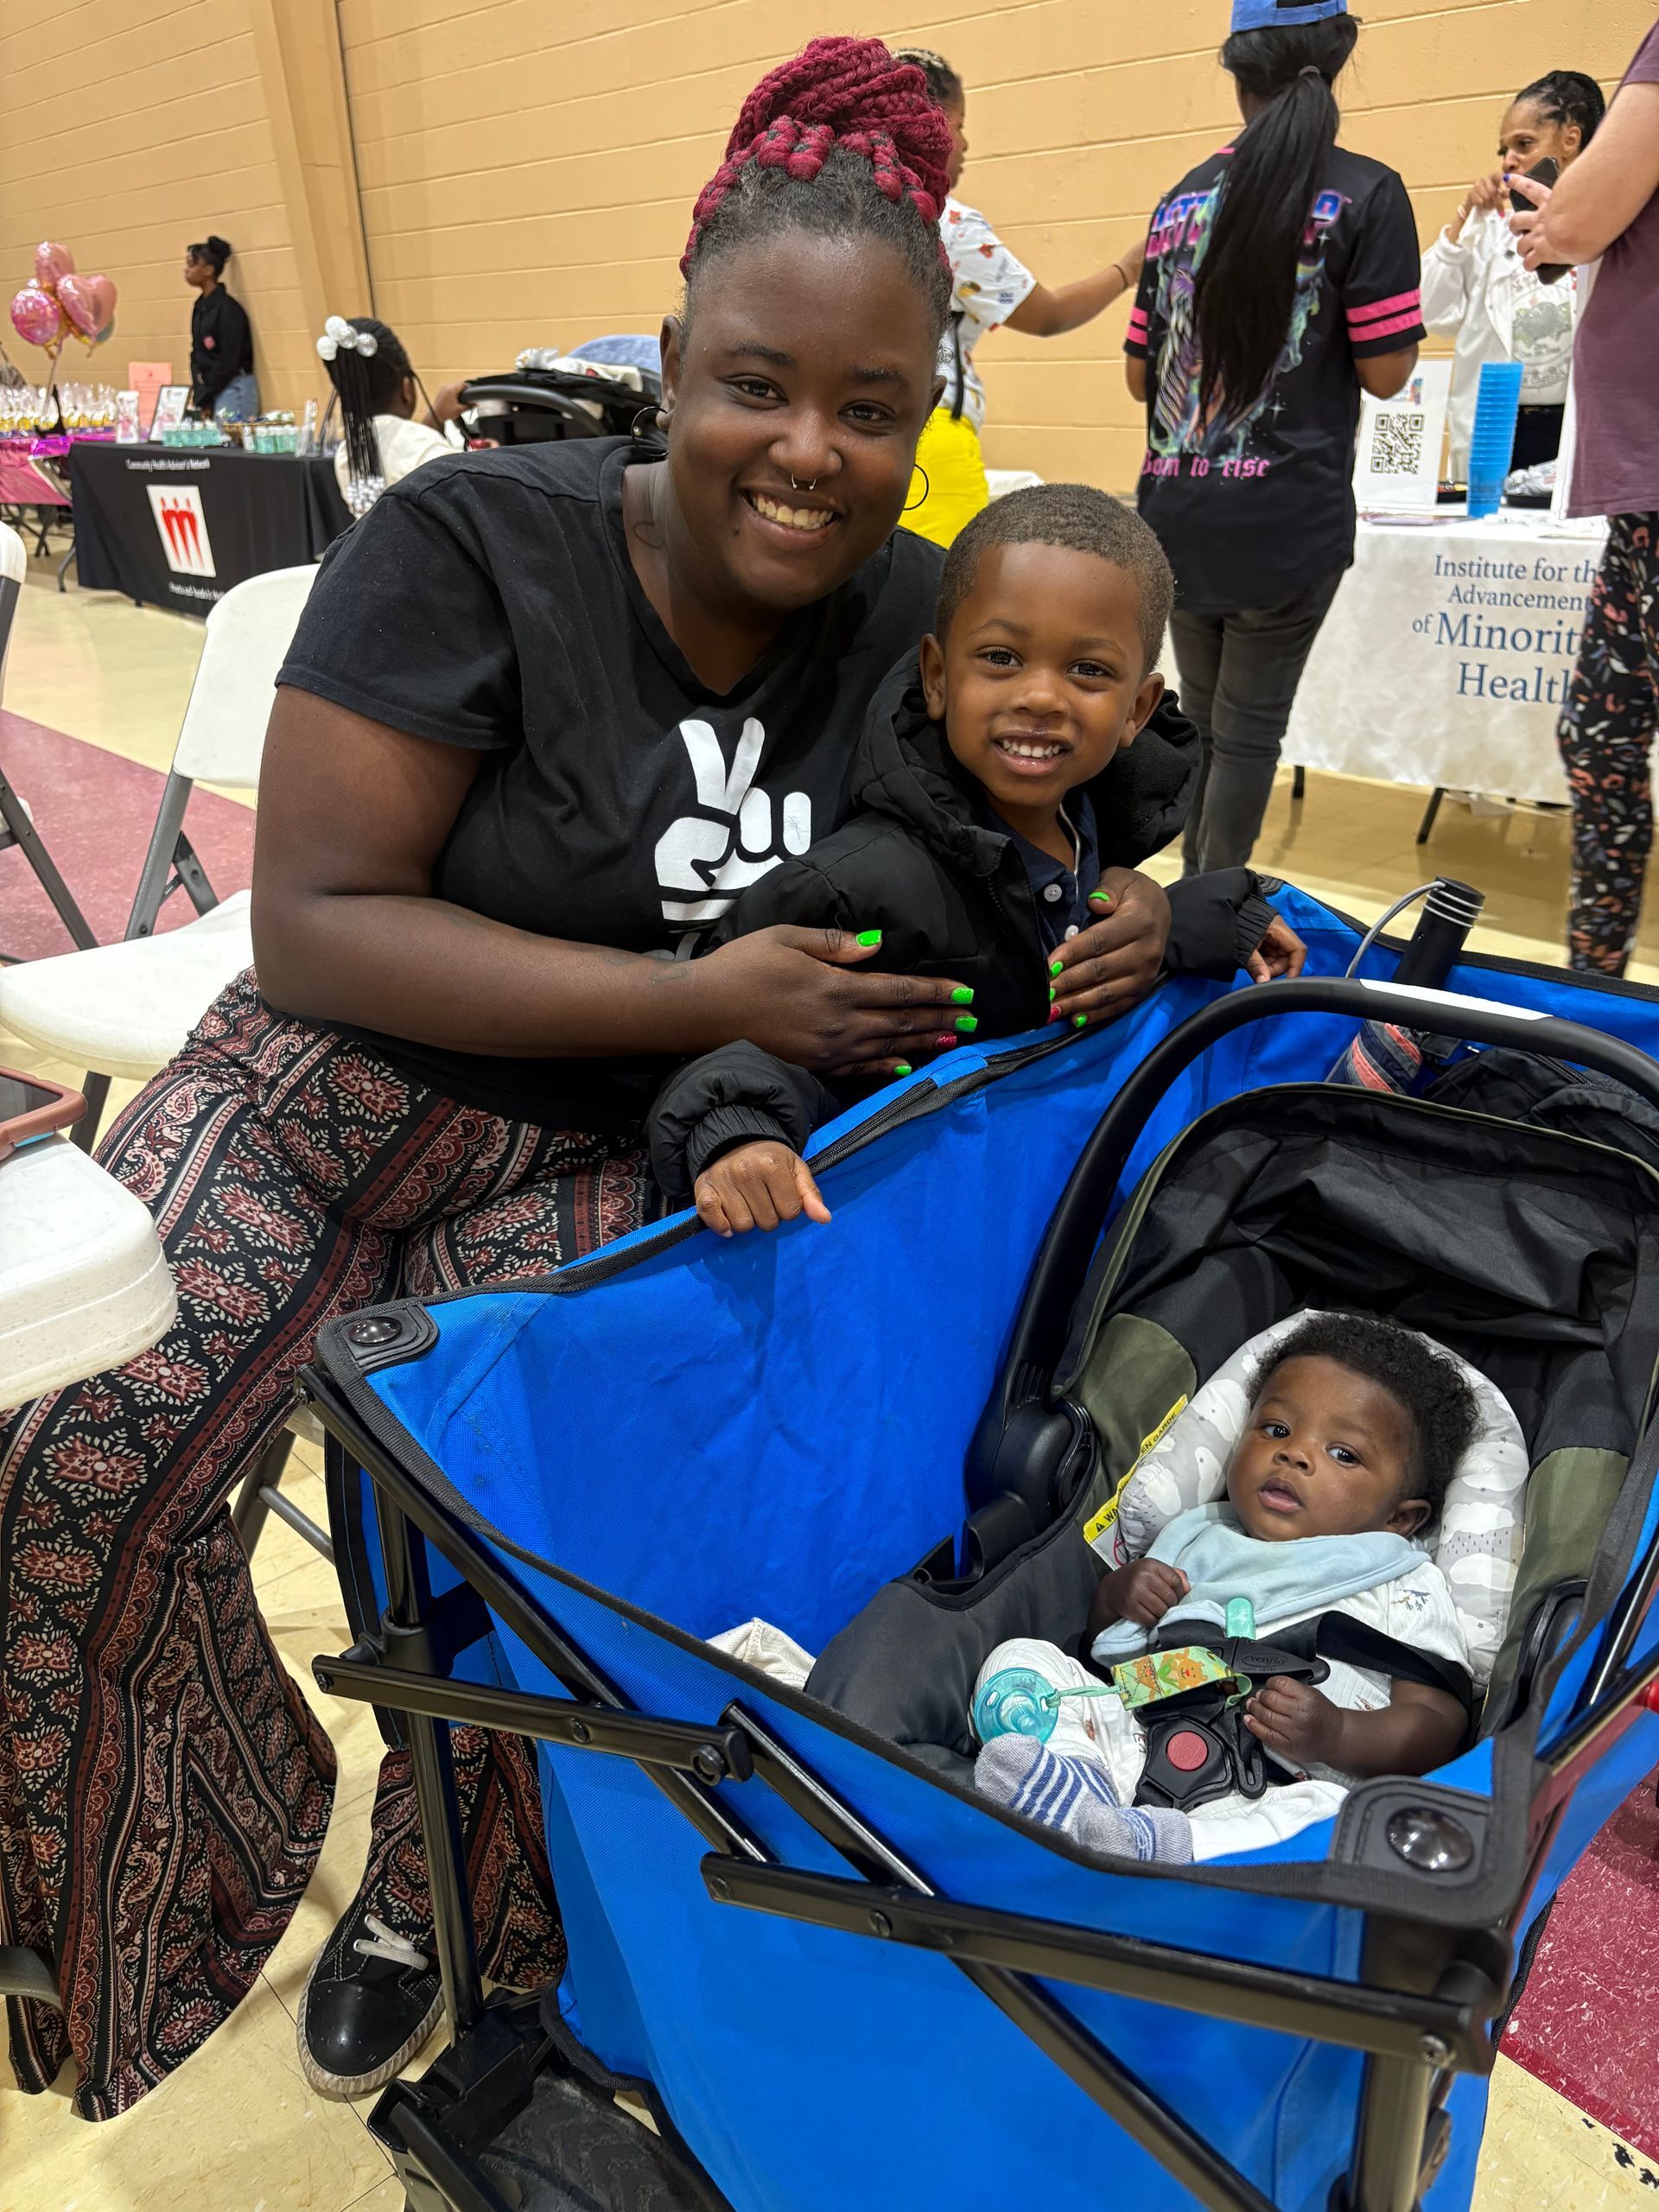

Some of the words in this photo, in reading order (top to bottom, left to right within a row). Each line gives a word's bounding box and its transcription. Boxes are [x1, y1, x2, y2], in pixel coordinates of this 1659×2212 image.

[1190, 454, 1210, 477] to
[1222, 453, 1271, 478] rise
[1434, 553, 1527, 581] Institute
[1532, 556, 1568, 582] for
[1573, 558, 1597, 583] th
[1412, 613, 1433, 634] of
[1434, 611, 1583, 656] Minorit
[1141, 1441, 1153, 1453] EN
[1154, 1412, 1177, 1442] GARDE
[1243, 1654, 1286, 1666] evenflo
